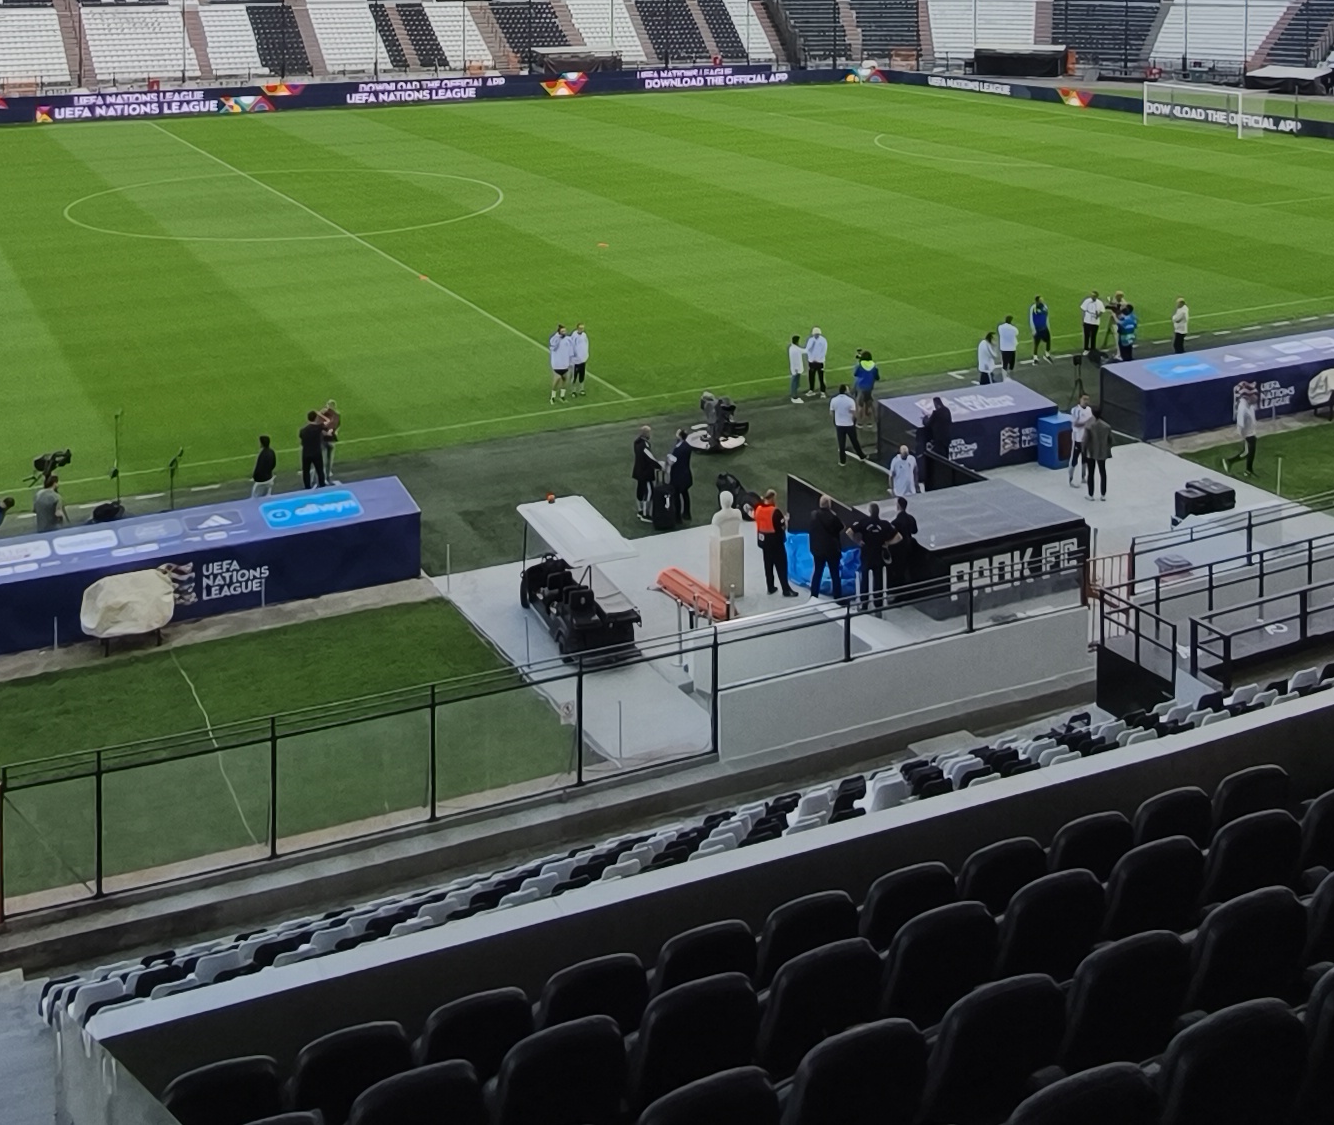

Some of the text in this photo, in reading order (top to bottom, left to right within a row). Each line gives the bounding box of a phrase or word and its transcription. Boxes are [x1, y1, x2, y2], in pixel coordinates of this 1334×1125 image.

[645, 73, 788, 89] DOWNLOAD THE OFFICIAL APP
[74, 90, 205, 106] UEFA NATIONS LEAGUE
[346, 88, 476, 104] UEFA NATIONS LEAGUE
[54, 99, 218, 119] UEFA NATIONS LEAGUE
[1206, 110, 1227, 124] THE
[1260, 380, 1281, 391] UEFA
[1260, 385, 1295, 400] NATIONS
[202, 565, 270, 588] NATIONS
[203, 560, 240, 577] UEFA
[950, 537, 1078, 602] PAOK FC
[202, 579, 262, 601] LEAGUE
